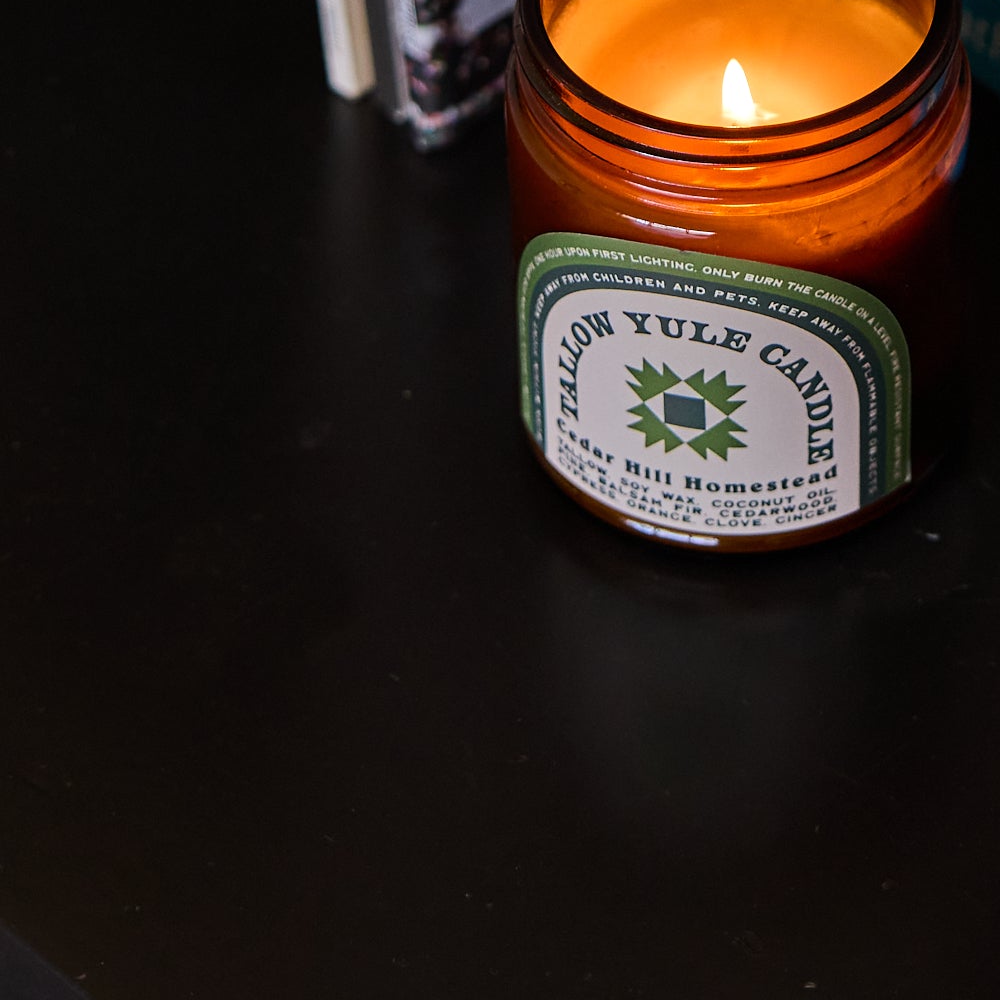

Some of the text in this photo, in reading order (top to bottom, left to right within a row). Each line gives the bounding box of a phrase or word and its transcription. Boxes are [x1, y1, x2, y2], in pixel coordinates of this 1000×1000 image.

[563, 246, 591, 258] UPON
[591, 248, 626, 261] FIRST
[629, 253, 698, 273] LIGHTING.
[702, 265, 741, 279] ONLY
[743, 273, 784, 288] BURN
[787, 281, 814, 295] THE
[814, 288, 858, 312] CANDLE
[855, 306, 870, 320] ON
[558, 310, 615, 422] TALLOW
[622, 310, 752, 354] YULE
[759, 342, 835, 466] CANDLE
[561, 272, 590, 286] FROM
[592, 272, 666, 289] CHILDREN
[673, 282, 706, 295] AND
[713, 289, 761, 307] PETS.
[768, 301, 809, 319] KEEP
[810, 315, 843, 336] AWAY
[841, 333, 866, 362] FROM
[861, 361, 878, 434] FLAMMABLE
[557, 416, 838, 494] Cedar Hill Homestead
[598, 476, 662, 507] BALSAM
[620, 477, 650, 493] SOY
[711, 494, 796, 509] COCONUT
